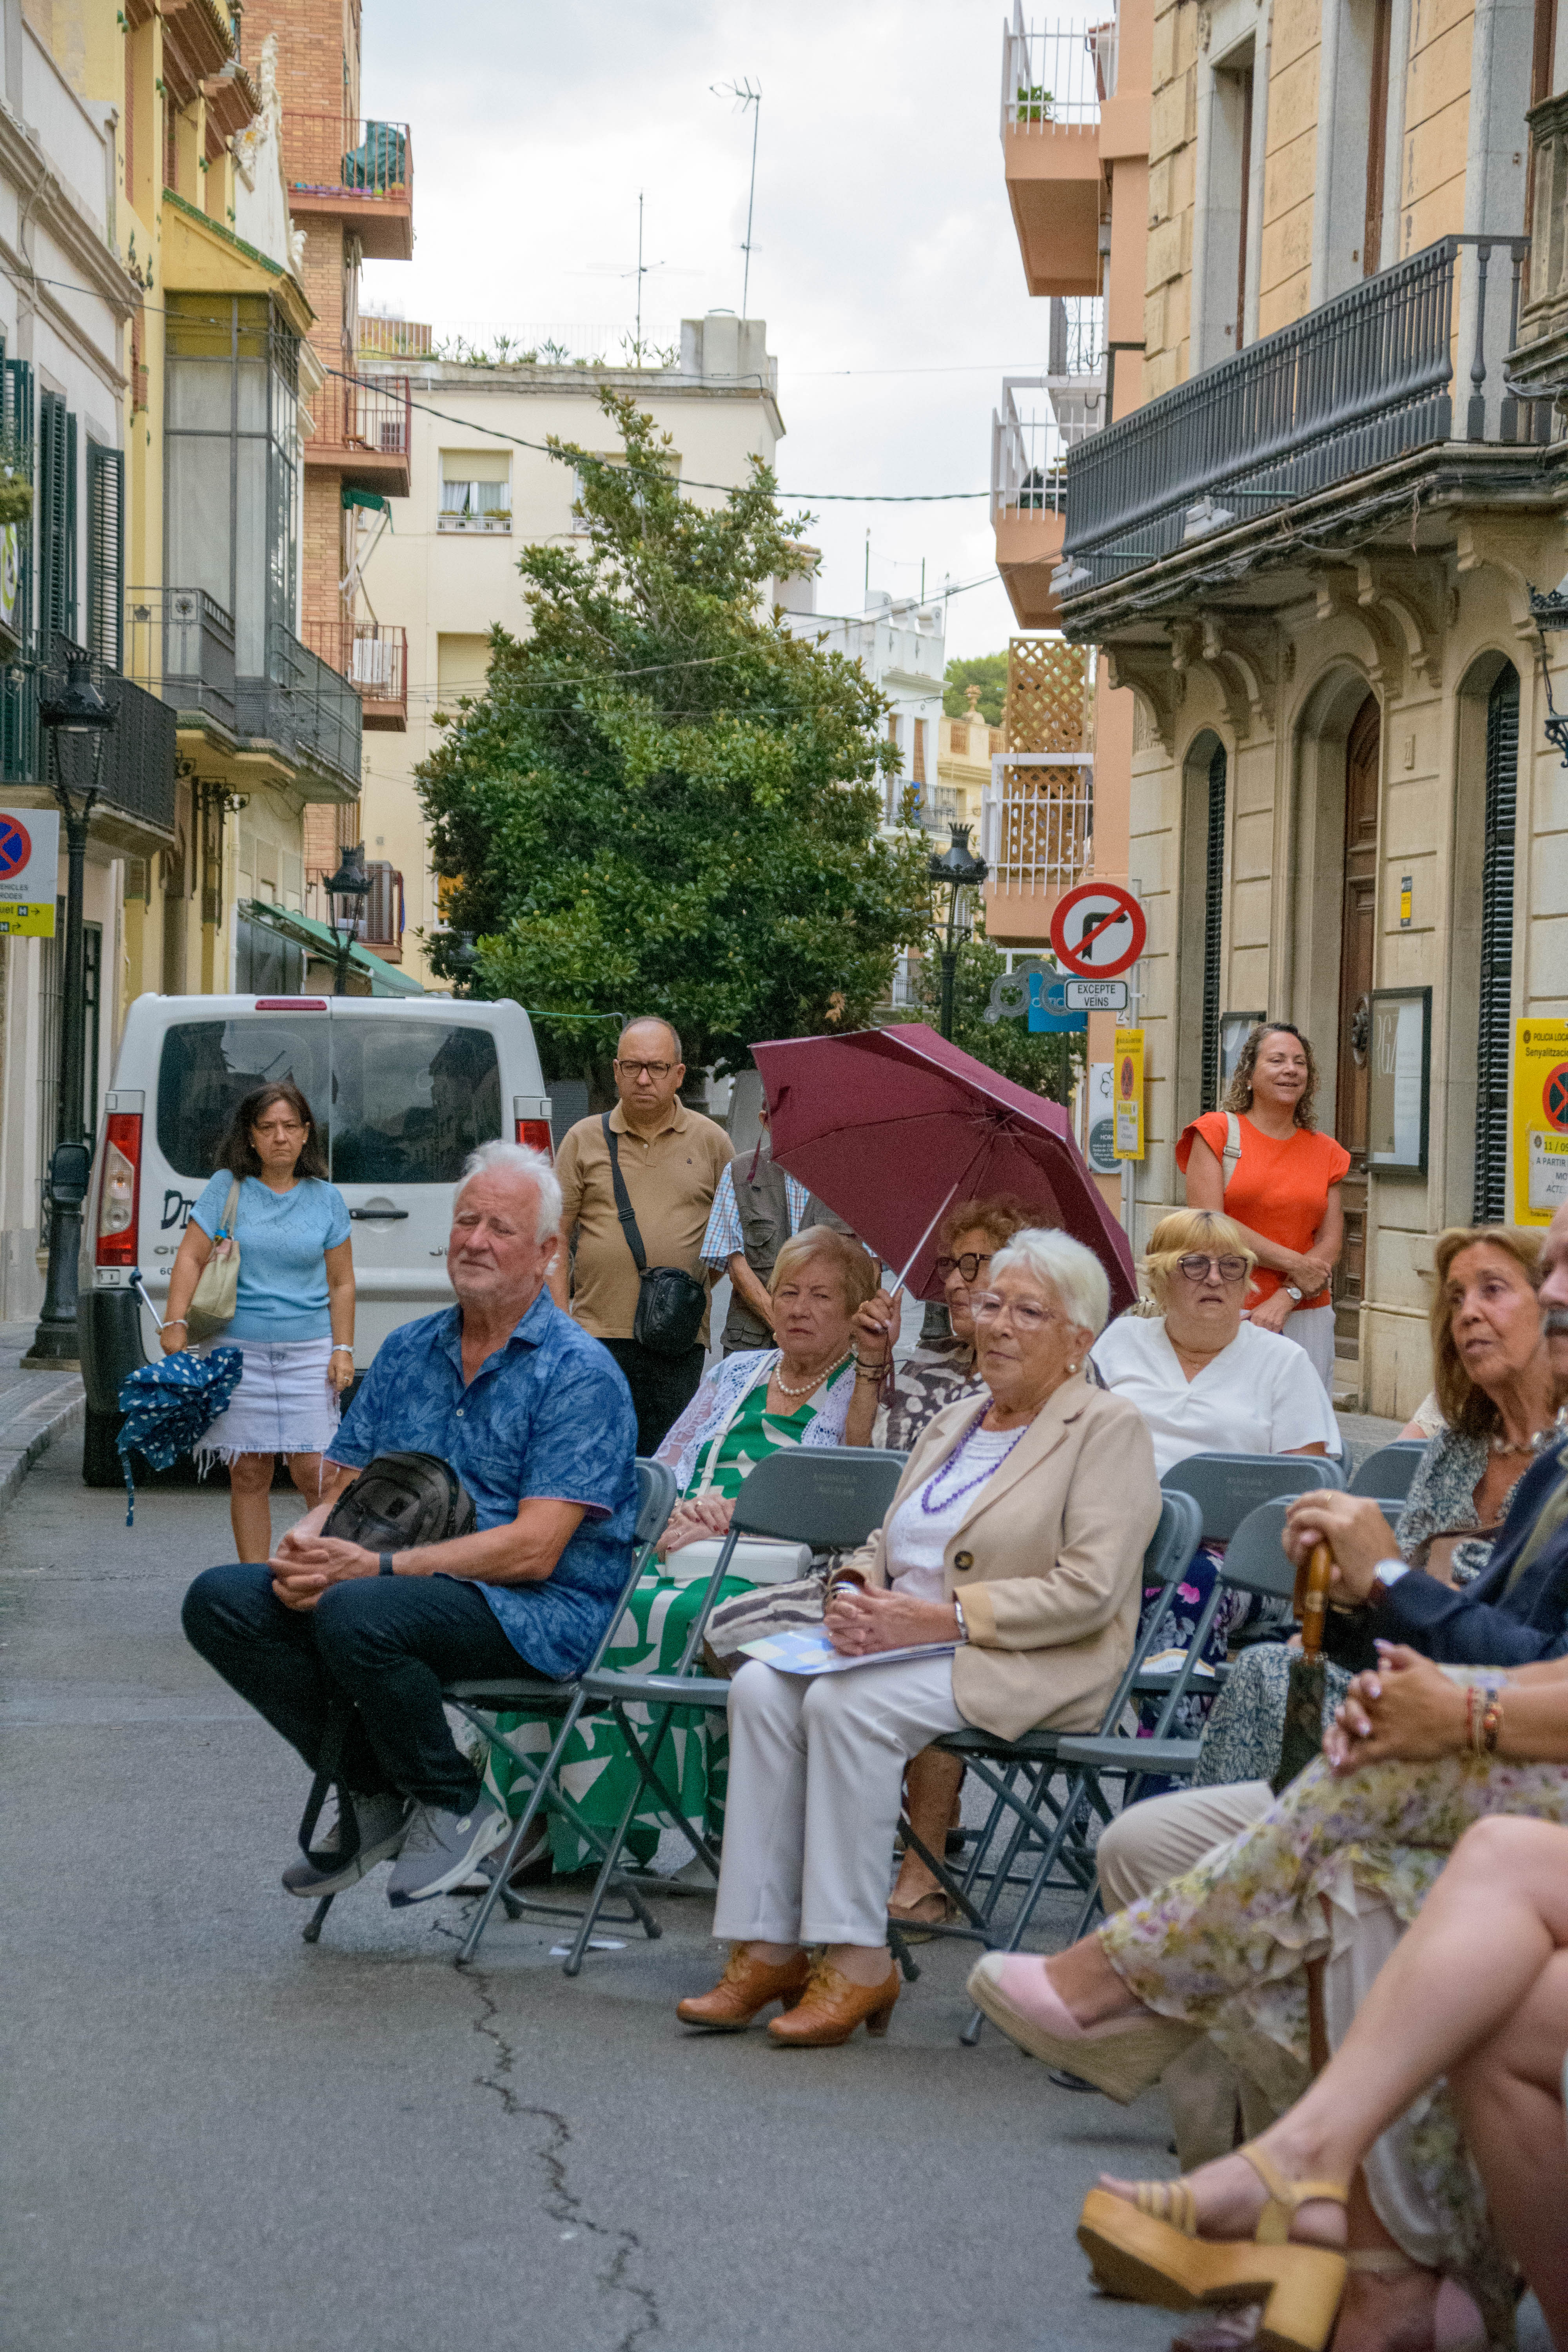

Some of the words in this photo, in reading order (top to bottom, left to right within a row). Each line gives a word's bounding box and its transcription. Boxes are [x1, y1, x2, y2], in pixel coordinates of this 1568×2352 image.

[1078, 984, 1116, 994] EXCEPTE
[1084, 995, 1109, 1006] VEÏNS
[1534, 1033, 1553, 1041] POLICIA
[1544, 1142, 1552, 1151] 11
[1543, 1157, 1566, 1167] PARTIR
